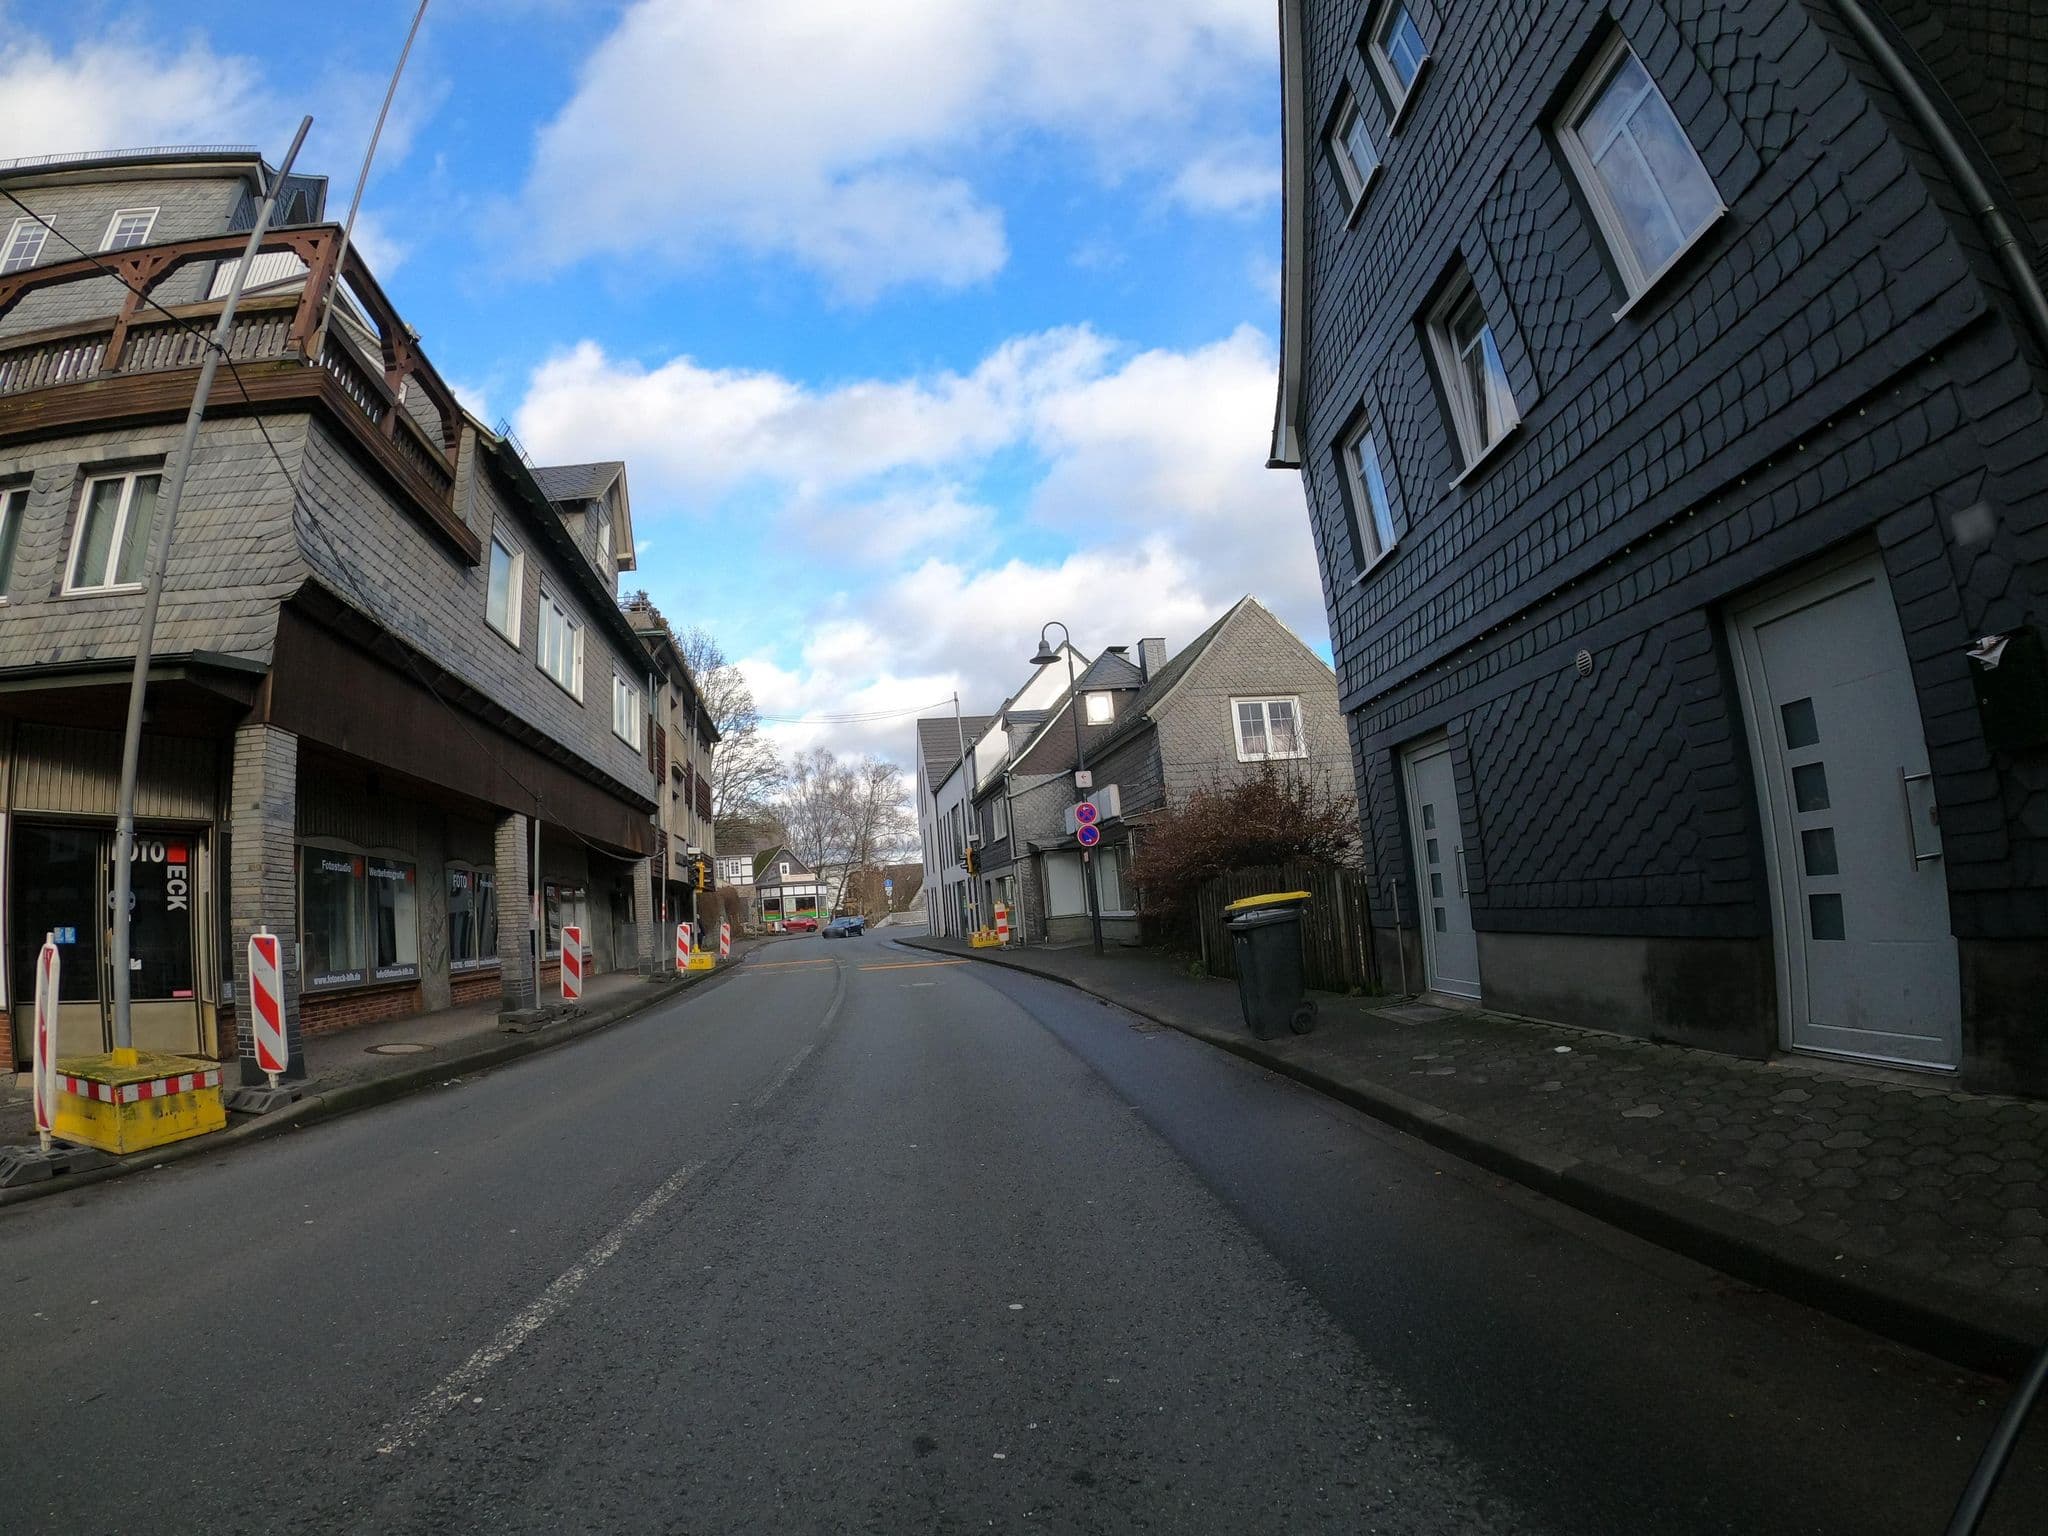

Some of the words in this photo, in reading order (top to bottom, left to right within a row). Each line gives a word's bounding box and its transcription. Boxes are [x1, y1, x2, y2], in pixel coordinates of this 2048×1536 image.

[321, 859, 352, 873] Fotostudio
[167, 865, 187, 911] ECK
[452, 874, 467, 888] FOTO
